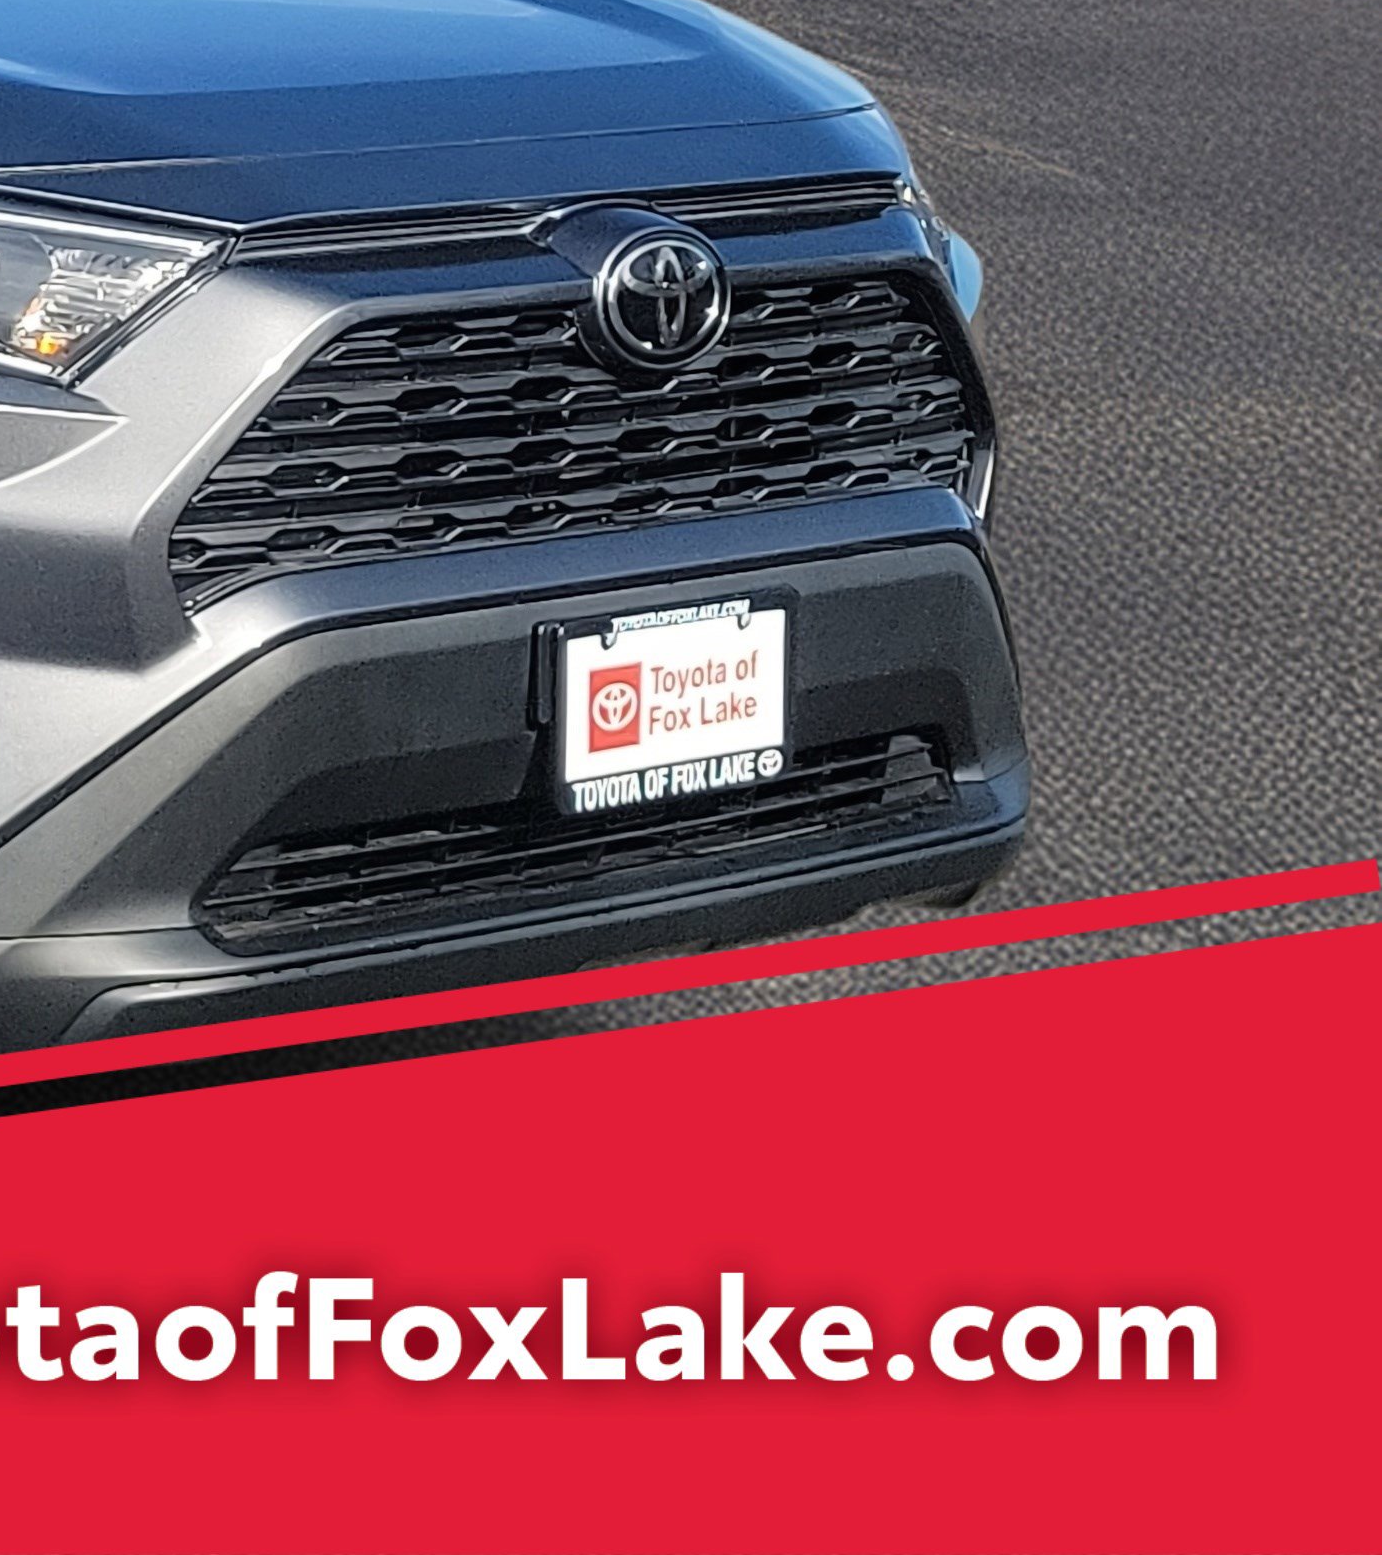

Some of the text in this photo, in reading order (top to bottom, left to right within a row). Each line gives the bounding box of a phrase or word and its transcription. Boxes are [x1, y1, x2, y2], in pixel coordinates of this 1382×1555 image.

[650, 649, 759, 699] Toyota of
[649, 692, 758, 735] Fox Lake
[571, 752, 756, 813] TOYOTA OF FOX LAKE
